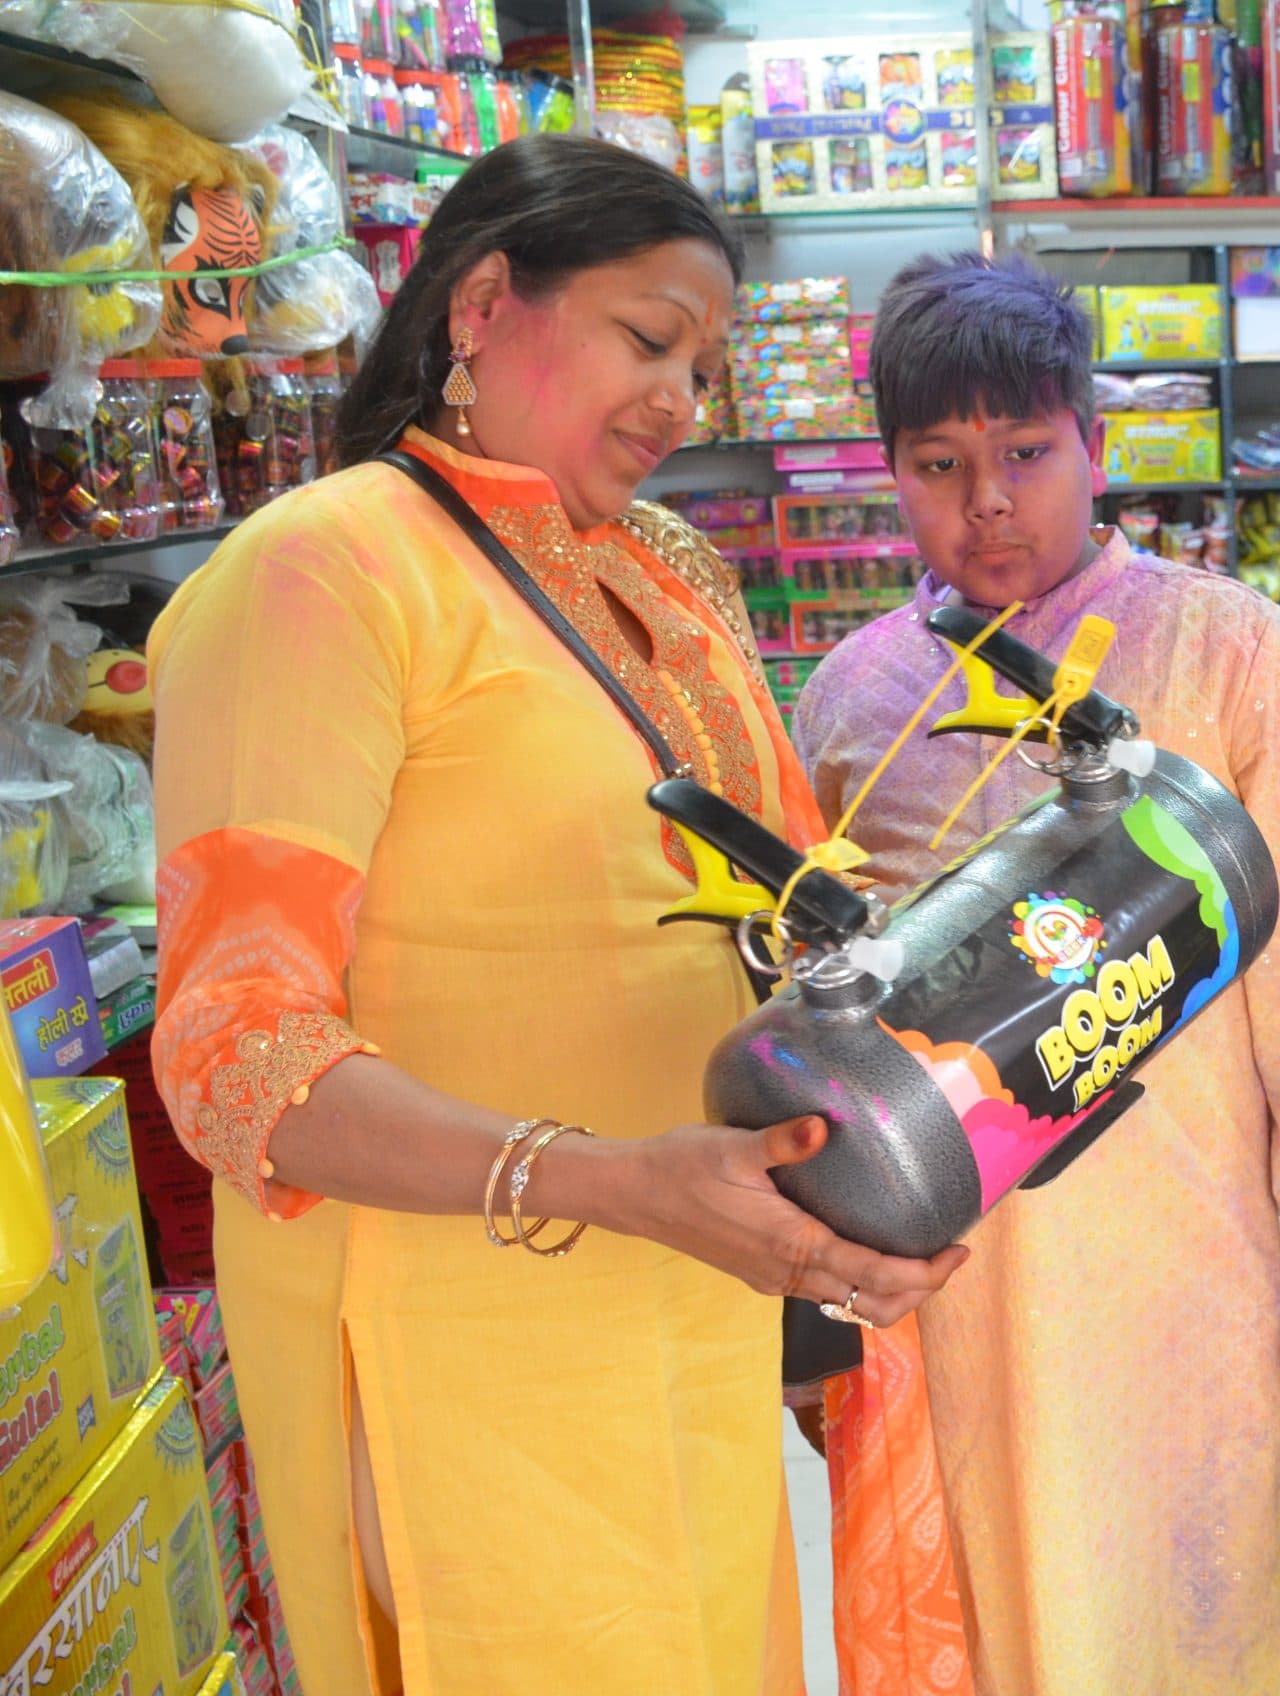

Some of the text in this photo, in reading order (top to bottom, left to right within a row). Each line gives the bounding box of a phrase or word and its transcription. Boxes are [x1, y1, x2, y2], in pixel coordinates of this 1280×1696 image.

[1055, 29, 1070, 153] Colour Cloud
[1036, 934, 1175, 1092] BOOM
[1073, 1005, 1162, 1112] BOOM
[0, 1303, 64, 1408] erbal
